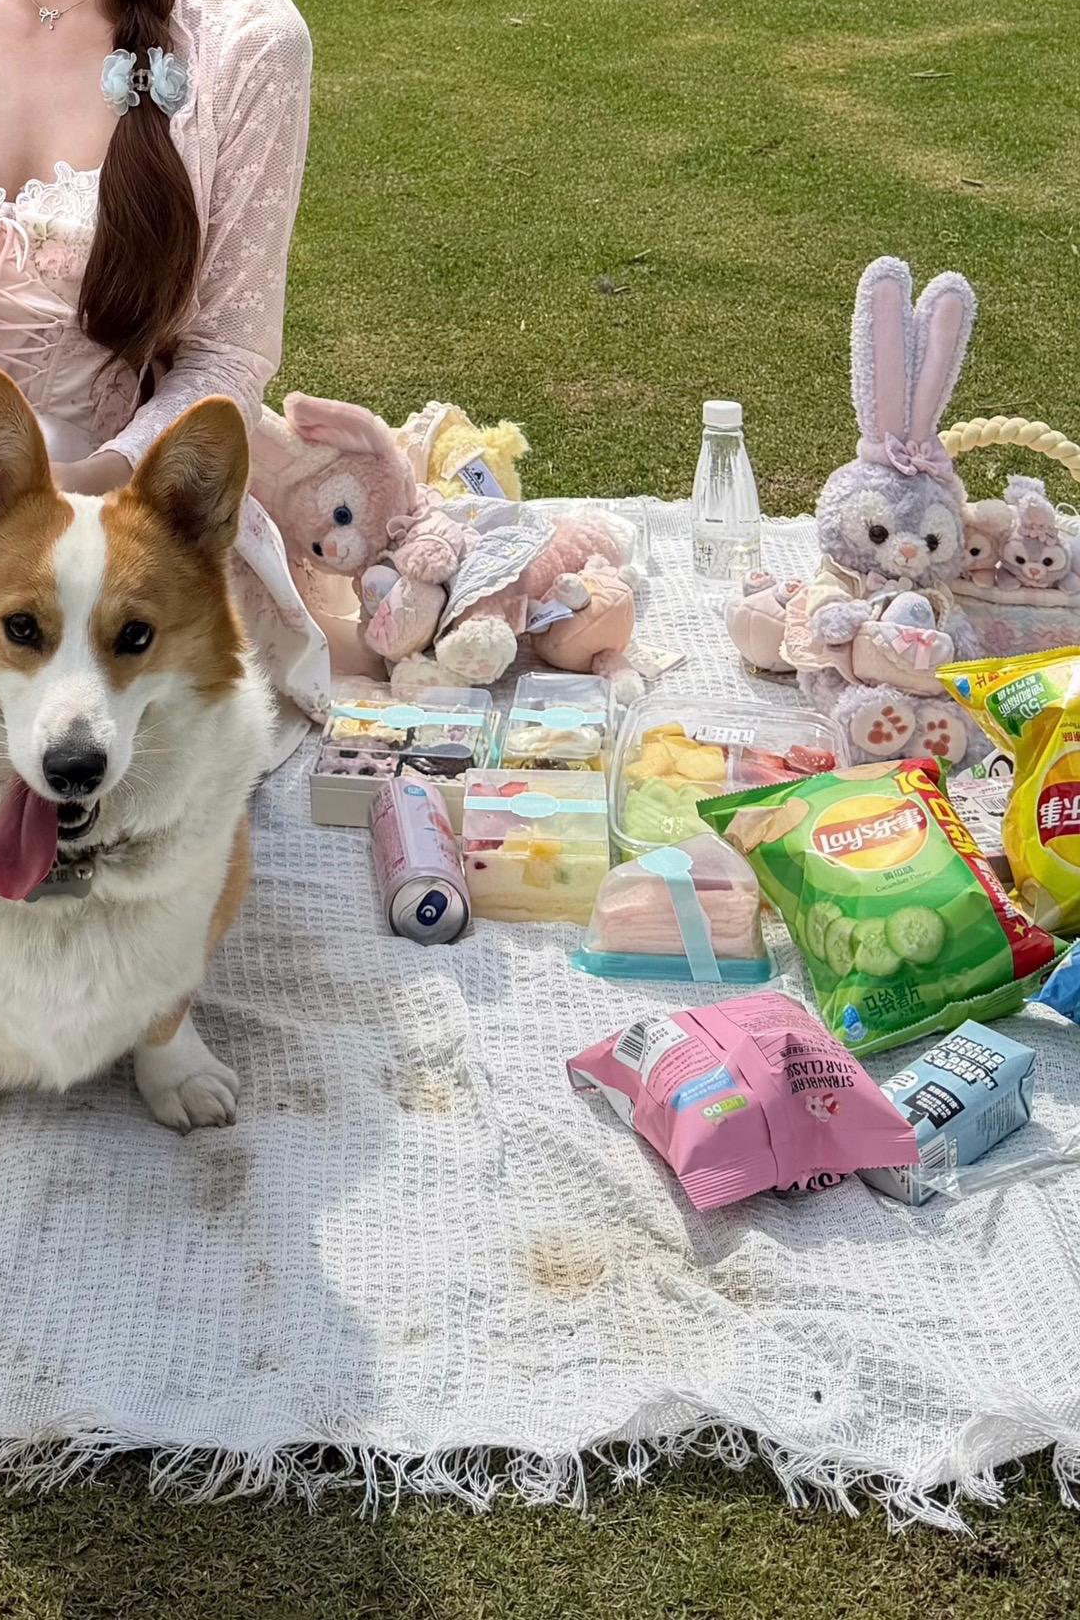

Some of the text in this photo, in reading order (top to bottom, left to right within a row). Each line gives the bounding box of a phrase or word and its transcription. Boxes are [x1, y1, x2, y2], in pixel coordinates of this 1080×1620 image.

[819, 823, 875, 854] Lay's
[863, 979, 921, 1018] 马铃薯片
[951, 1035, 1005, 1065] HELLO
[826, 1060, 857, 1075] STAR
